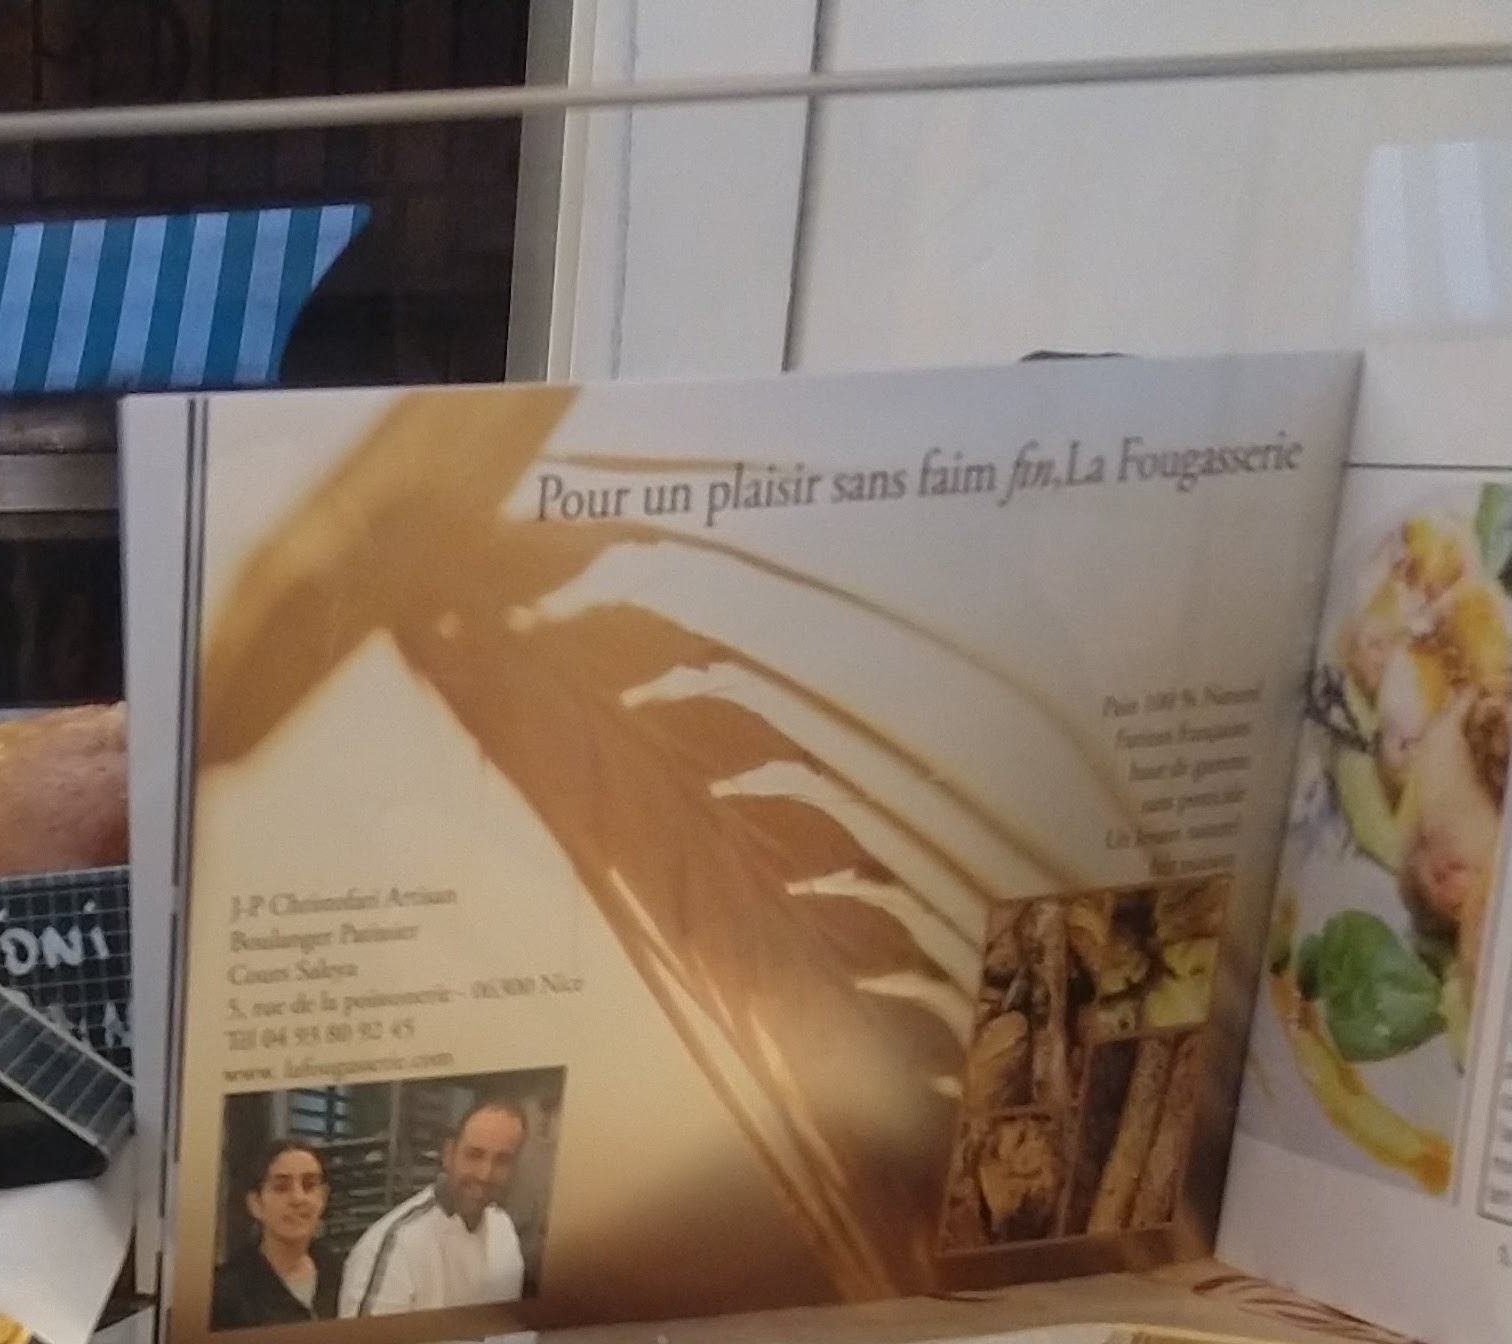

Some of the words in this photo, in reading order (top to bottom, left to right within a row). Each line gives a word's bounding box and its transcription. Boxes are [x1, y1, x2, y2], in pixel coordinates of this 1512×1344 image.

[537, 474, 631, 522] Pour
[643, 482, 691, 516] un
[704, 461, 822, 528] plaisir
[830, 468, 908, 503] sans
[918, 446, 997, 497] faim
[1117, 430, 1303, 492] Fougasserie
